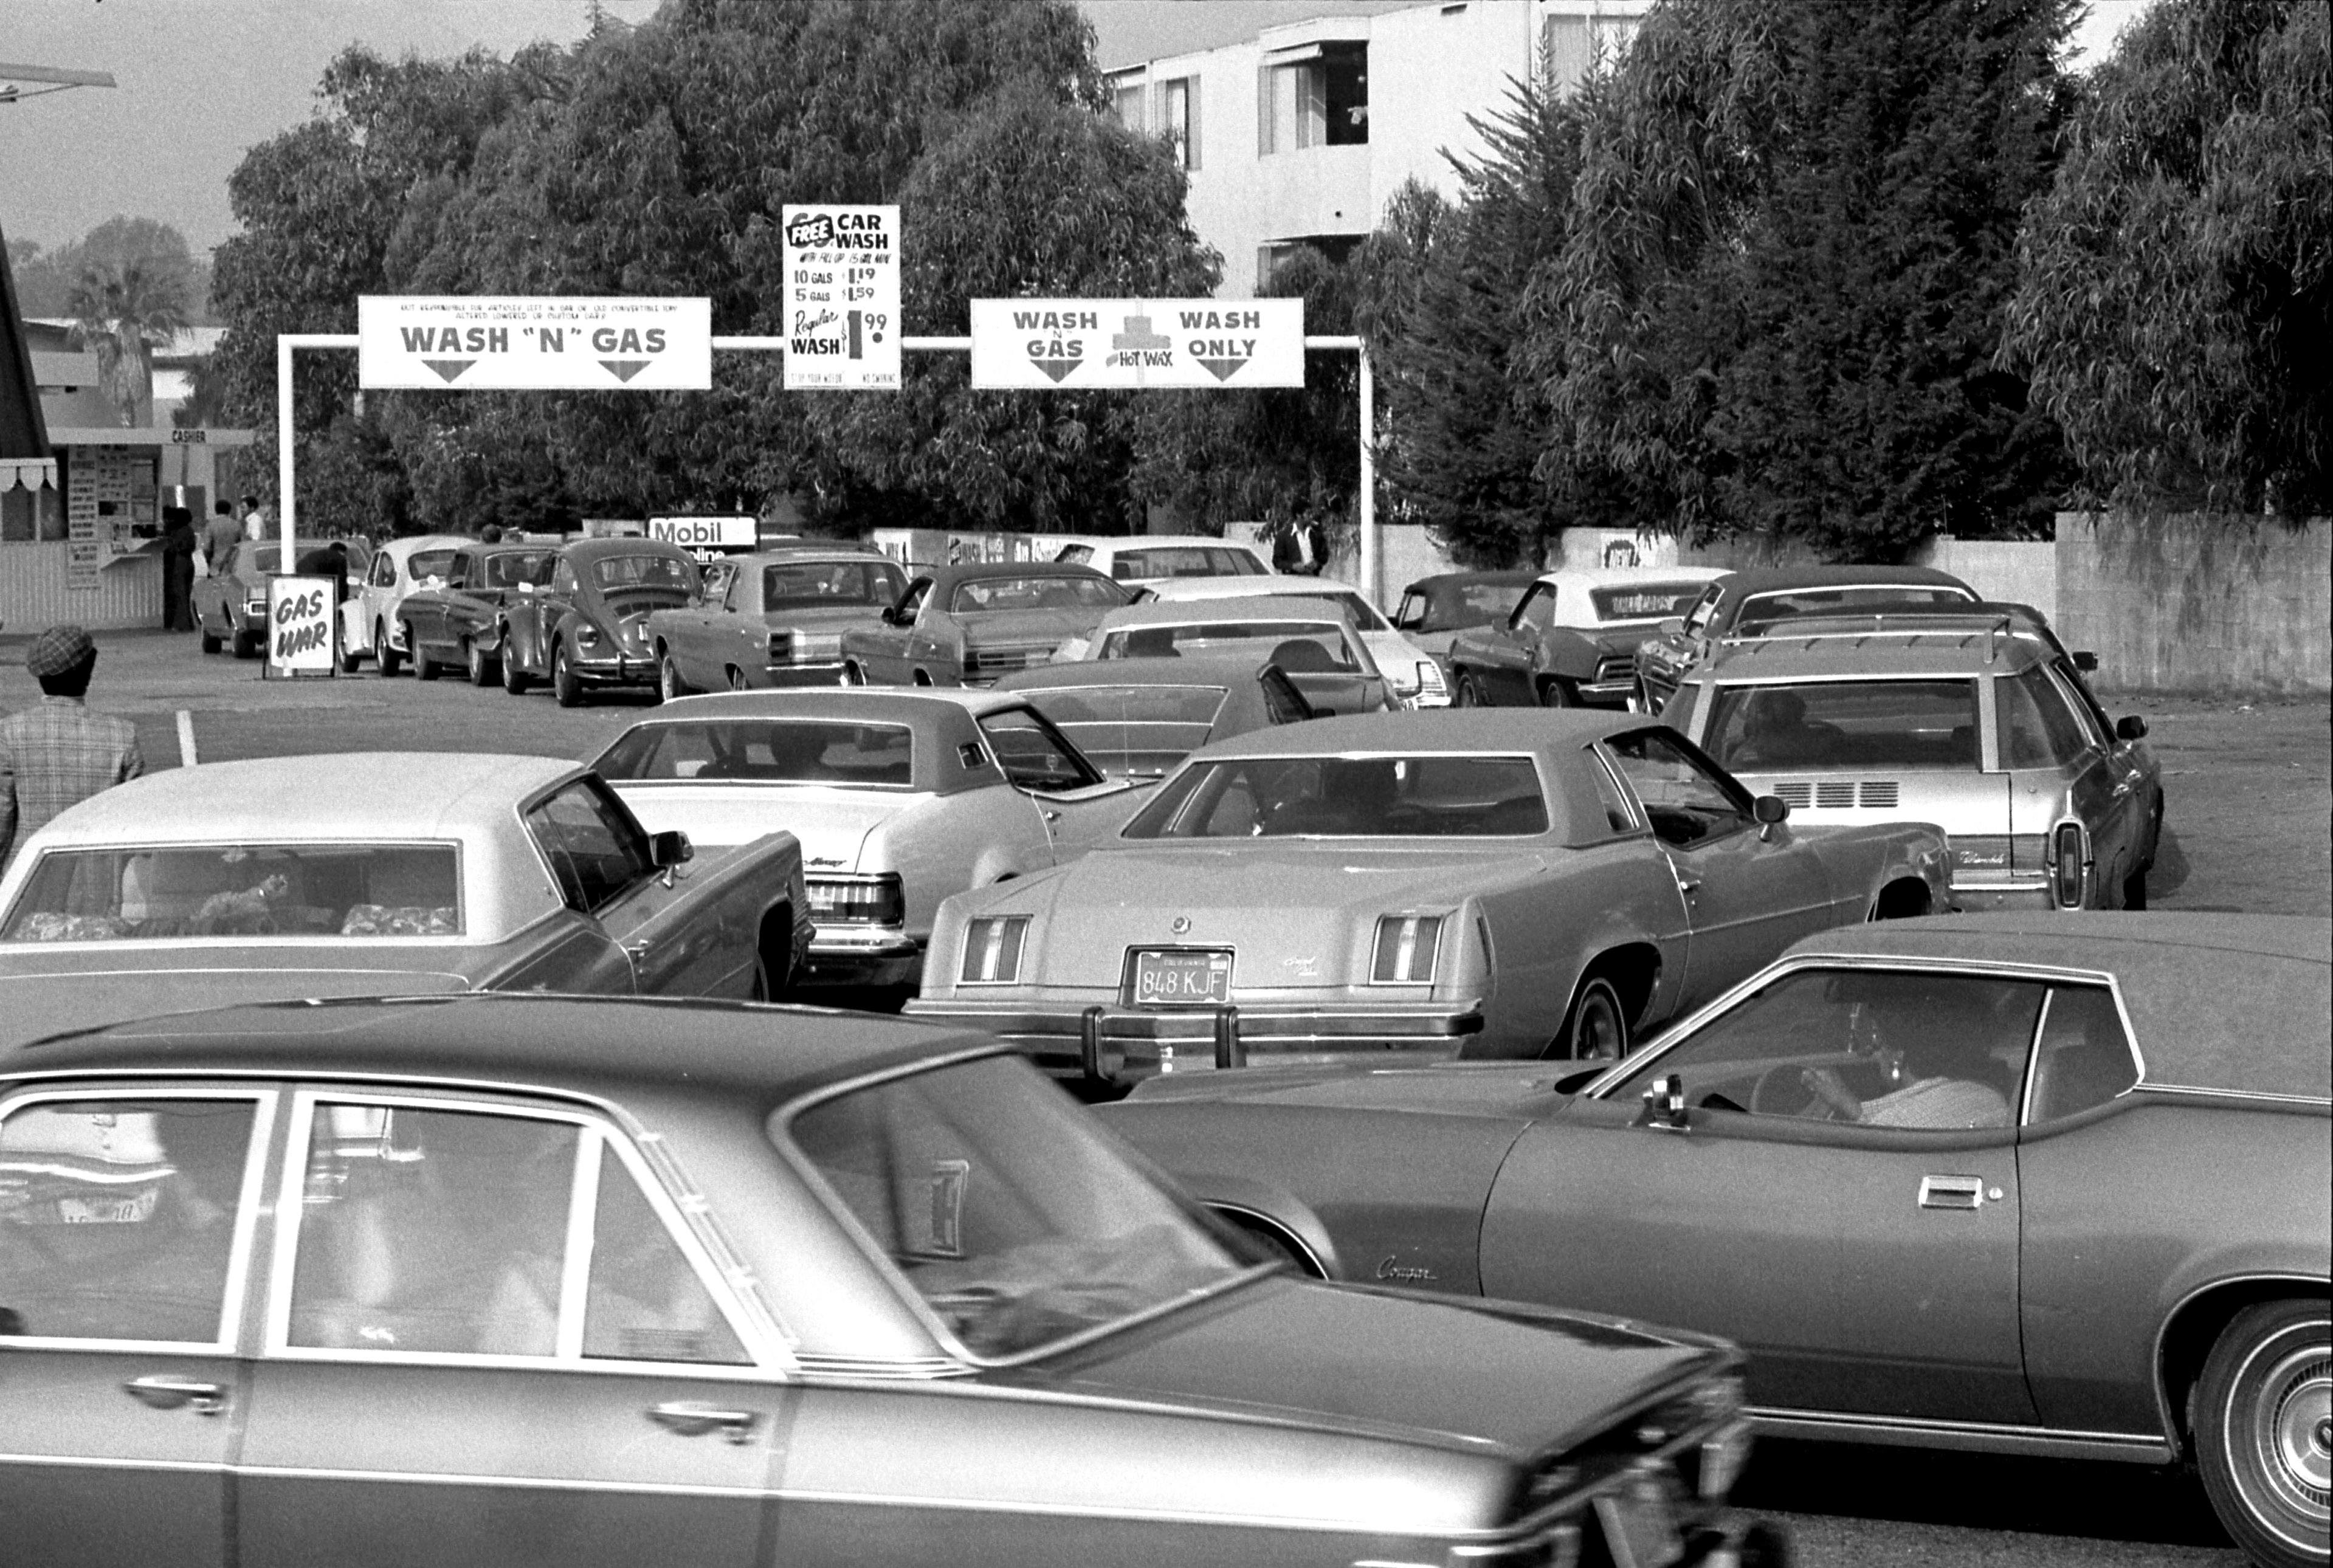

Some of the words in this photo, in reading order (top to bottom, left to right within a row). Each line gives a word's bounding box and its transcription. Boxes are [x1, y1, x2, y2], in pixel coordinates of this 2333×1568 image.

[837, 213, 881, 230] CAR
[791, 219, 829, 243] FREE
[836, 233, 888, 249] WASH
[794, 269, 808, 284] 10
[811, 272, 833, 284] GALS
[795, 287, 807, 301] 5
[810, 291, 830, 301] GALS
[794, 308, 839, 337] Regular
[1013, 311, 1098, 329] WASH
[1179, 311, 1261, 329] WASH
[400, 326, 509, 353] WASH
[523, 326, 582, 353] "N"
[591, 327, 667, 354] GAS
[791, 338, 839, 355] WASH
[1026, 339, 1084, 357] GAS
[1188, 339, 1257, 357] ONLY
[1143, 351, 1173, 366] WAX
[173, 430, 205, 443] CASHIER
[654, 521, 722, 543] Mobil
[275, 589, 325, 625] GAS
[276, 621, 328, 658] WAR
[1143, 971, 1178, 994] 848
[1184, 971, 1224, 994] KJF
[1376, 1255, 1438, 1284] Cougar
